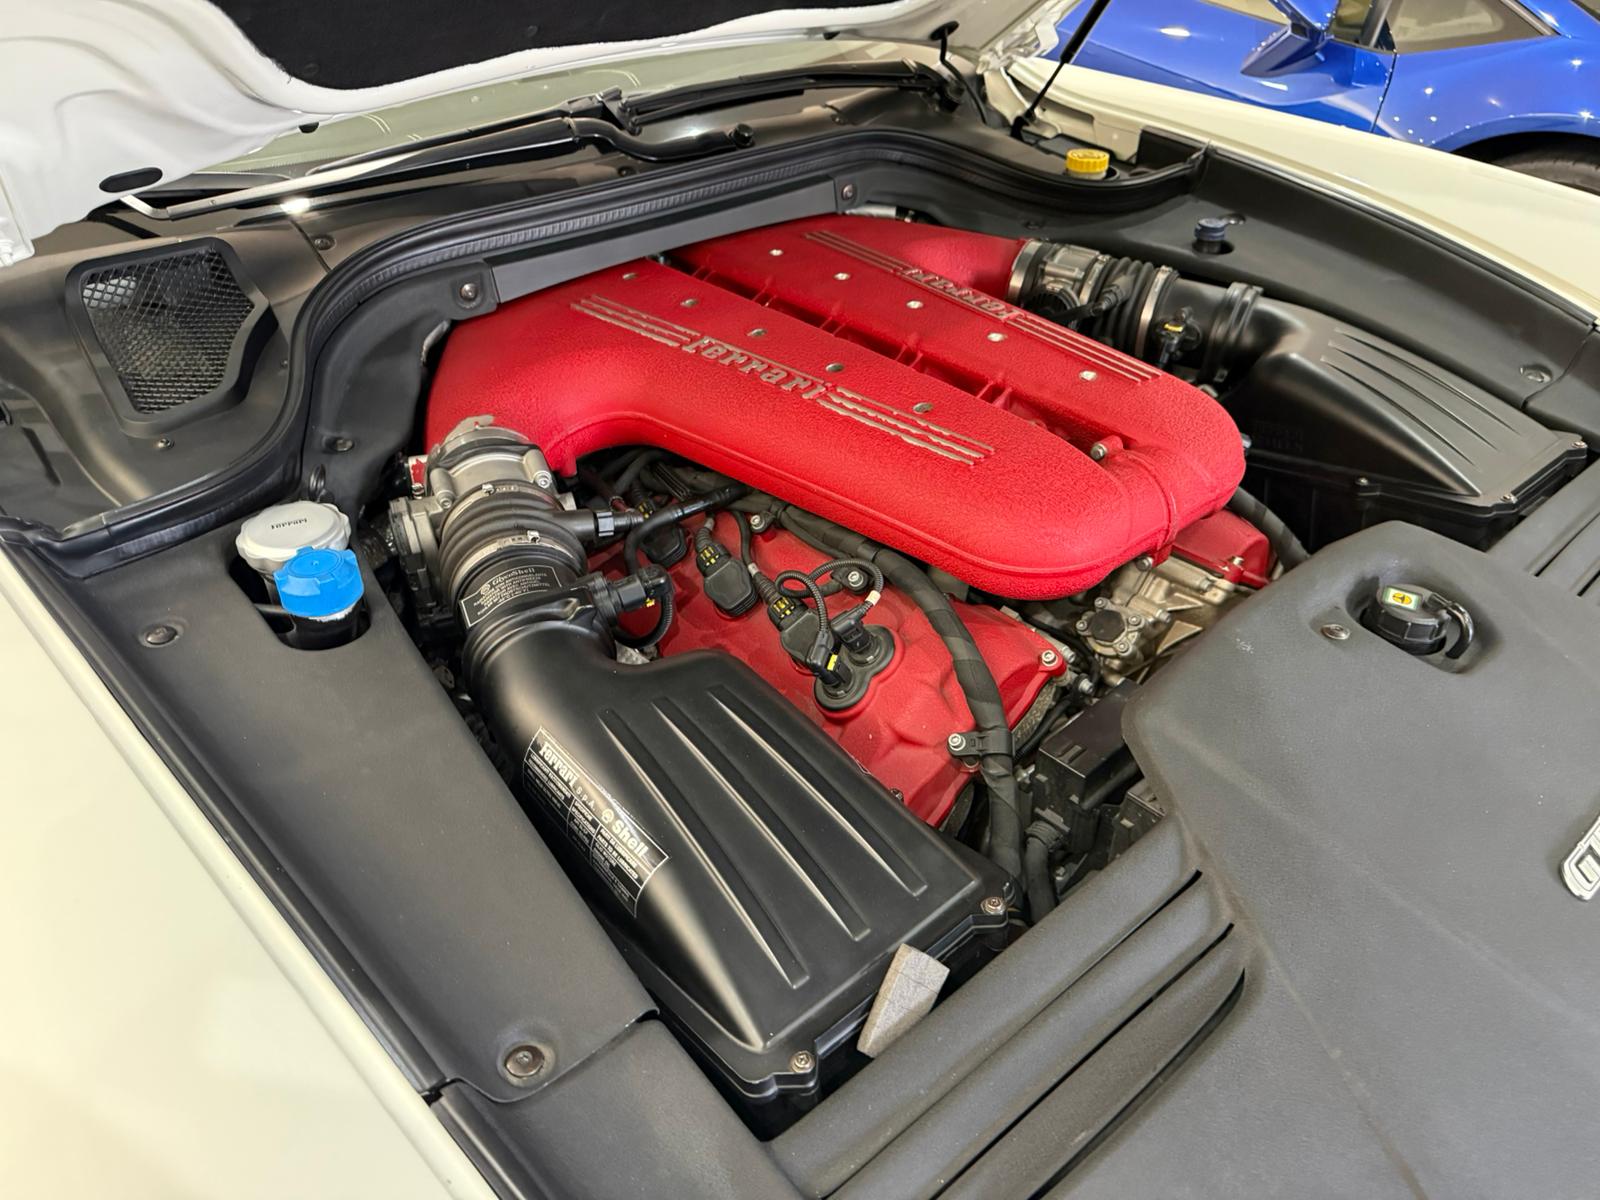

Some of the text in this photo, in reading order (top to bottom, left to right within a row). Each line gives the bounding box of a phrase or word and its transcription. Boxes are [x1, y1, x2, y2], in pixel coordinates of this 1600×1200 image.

[902, 267, 1025, 321] Ferrari
[682, 336, 826, 400] Ferrari
[539, 741, 580, 788] Ferrari
[611, 819, 649, 857] Shell
